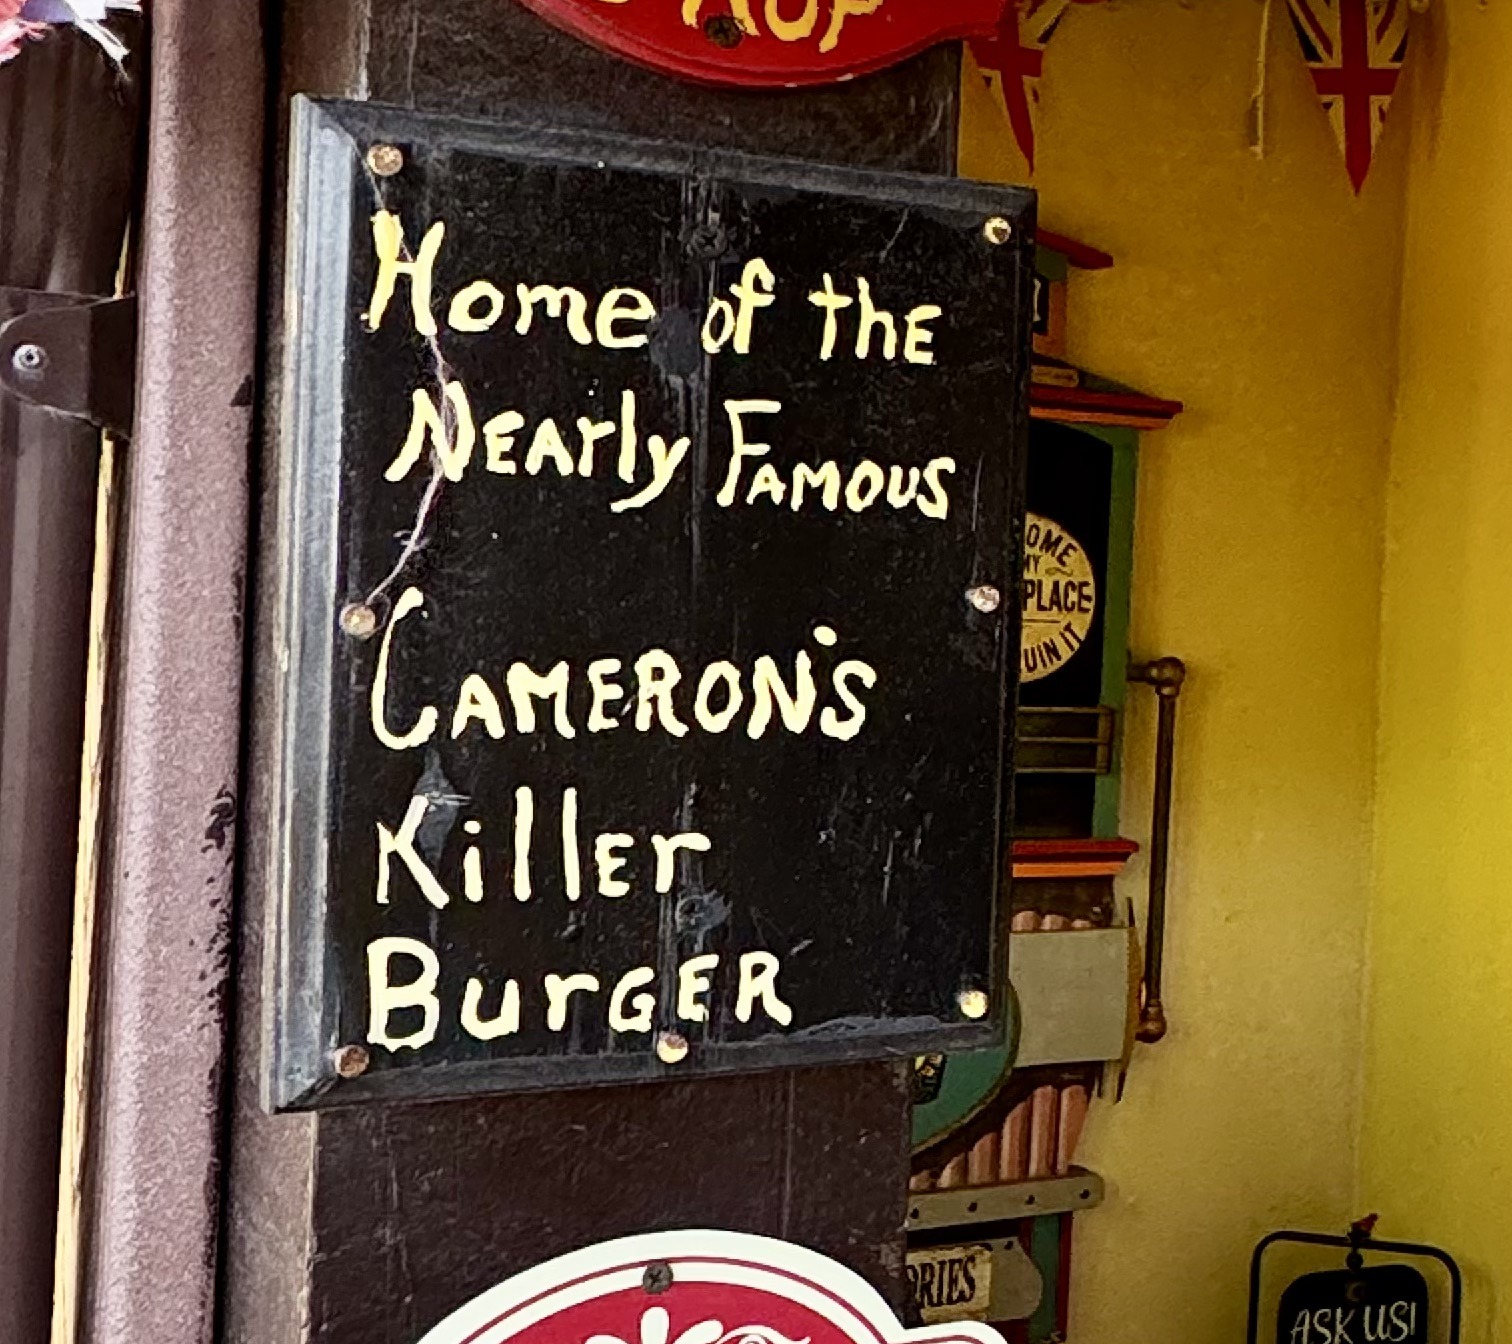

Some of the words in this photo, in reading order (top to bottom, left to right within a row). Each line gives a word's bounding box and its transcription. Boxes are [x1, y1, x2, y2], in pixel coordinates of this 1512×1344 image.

[360, 208, 655, 348] Home
[701, 256, 775, 355] of
[1026, 523, 1078, 568] OME
[1023, 578, 1093, 613] PLACE
[1024, 637, 1062, 674] UIN
[1059, 620, 1083, 652] IT
